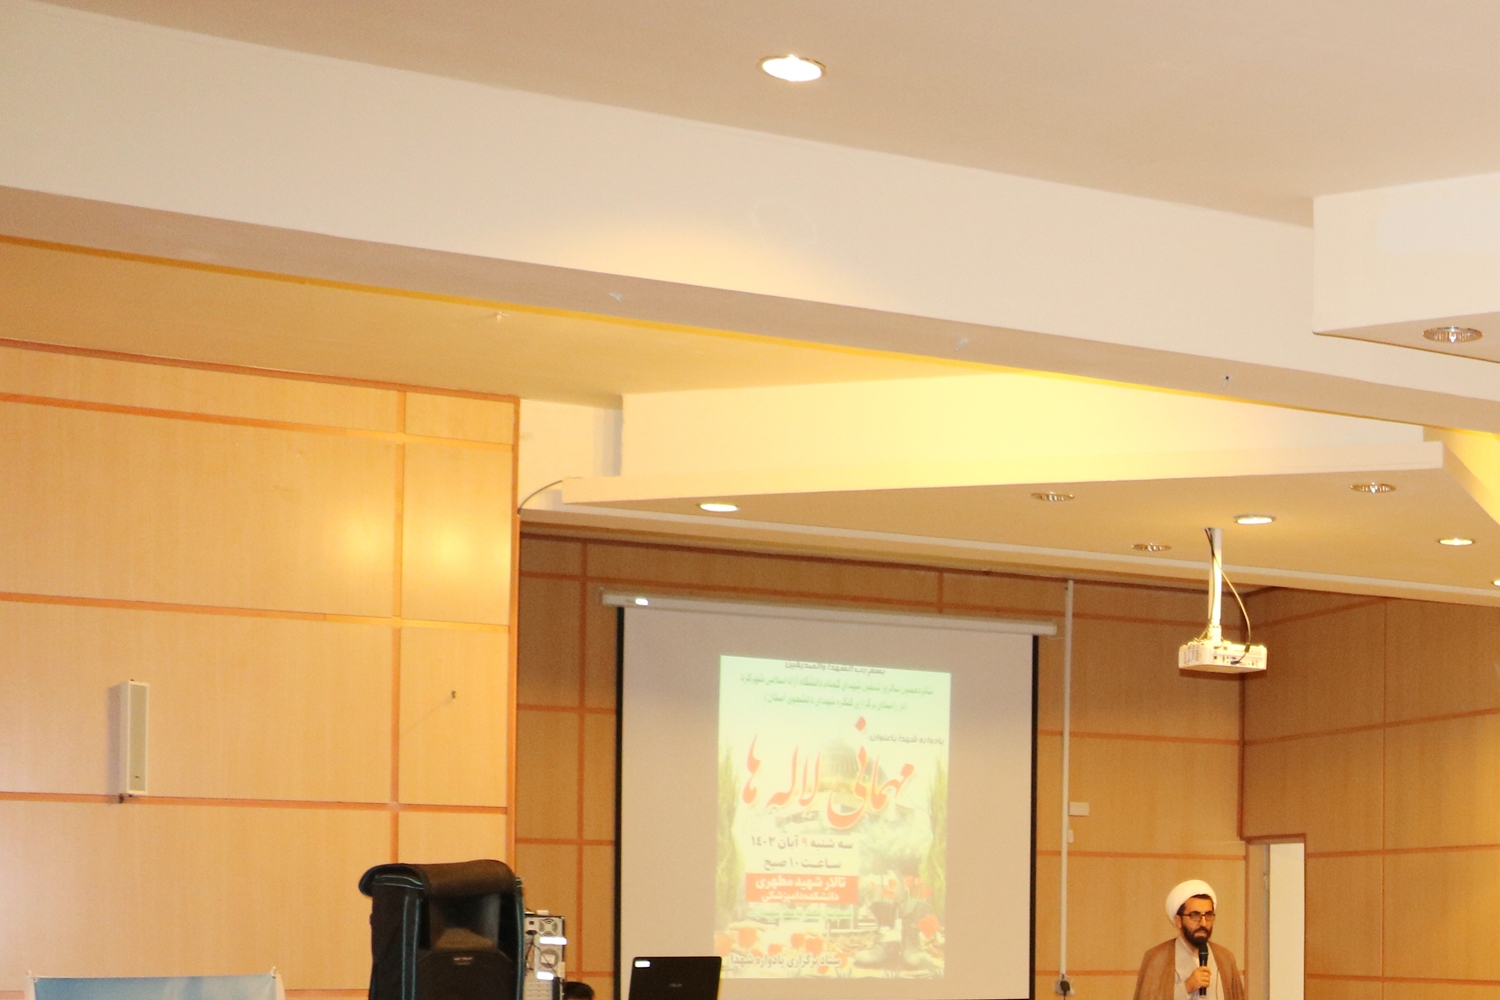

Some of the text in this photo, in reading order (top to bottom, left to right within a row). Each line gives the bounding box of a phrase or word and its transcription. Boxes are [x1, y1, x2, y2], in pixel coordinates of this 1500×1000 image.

[742, 716, 914, 828] مهمانی لاله ها
[778, 835, 798, 850] آبان
[810, 839, 835, 850] شنبه
[838, 840, 853, 849] سه
[764, 859, 786, 871] صبح
[801, 858, 841, 869] ساعت
[755, 875, 846, 891] تالار شهید مطهری
[731, 953, 840, 968] ستاد برگزاری یادواره شهدا
